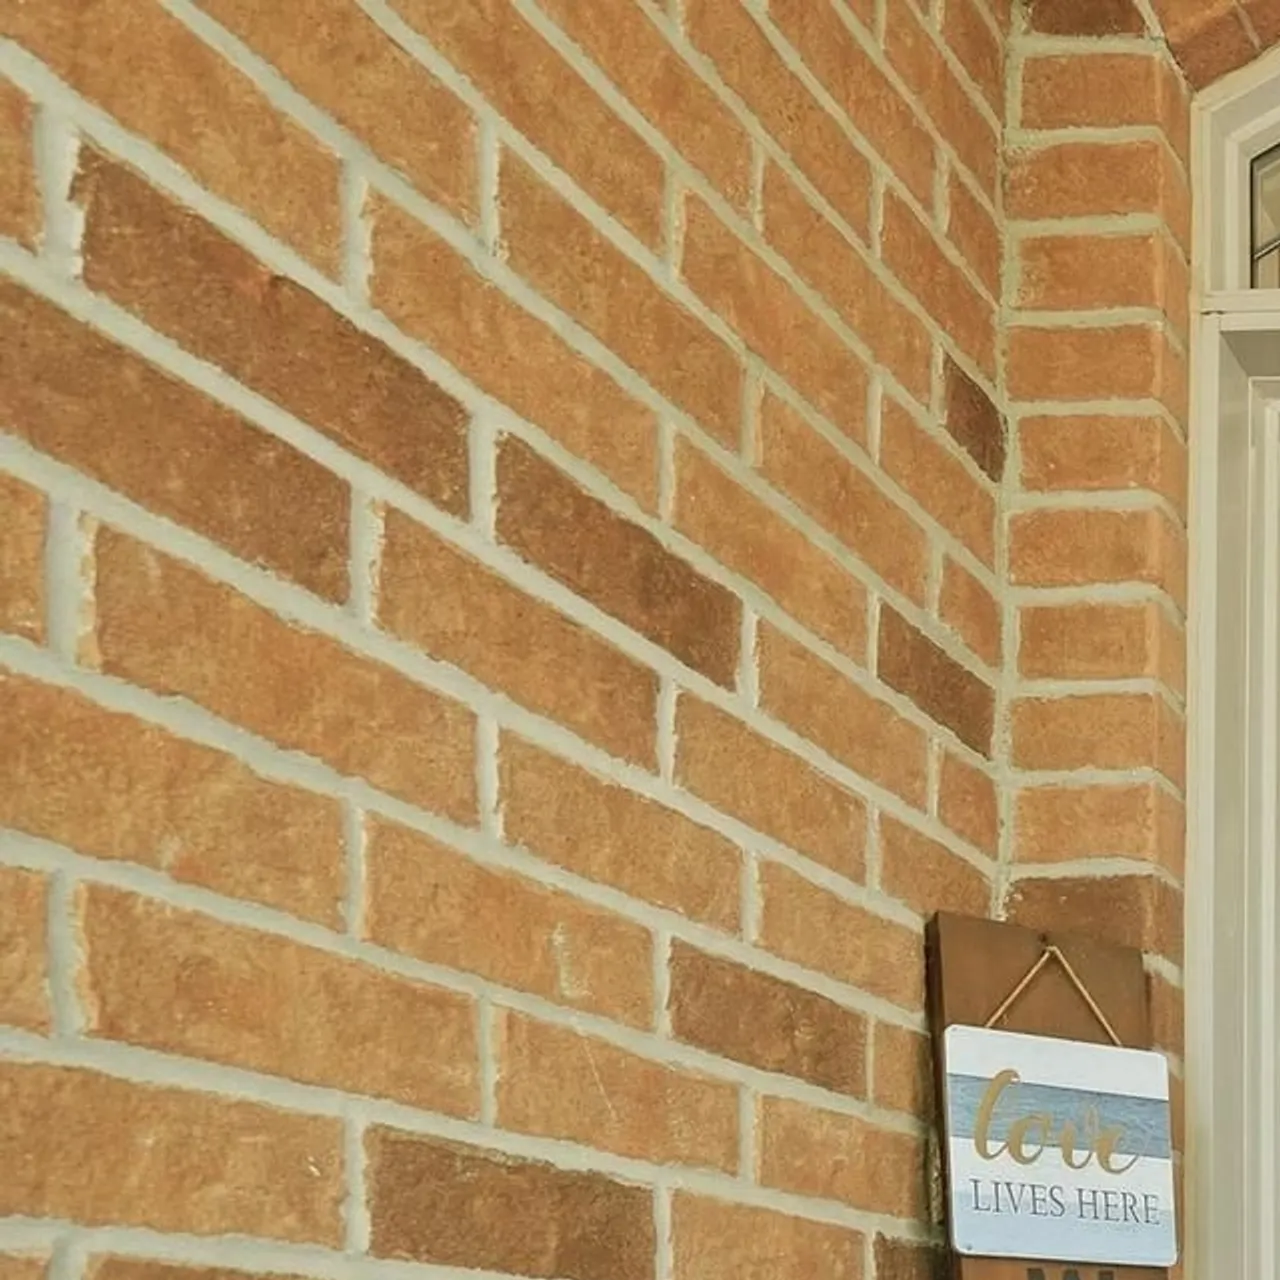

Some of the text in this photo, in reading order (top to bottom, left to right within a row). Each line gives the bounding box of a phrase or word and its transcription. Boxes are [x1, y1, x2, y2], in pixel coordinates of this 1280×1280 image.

[973, 1068, 1140, 1175] love
[970, 1178, 1161, 1226] LIVES HERE
